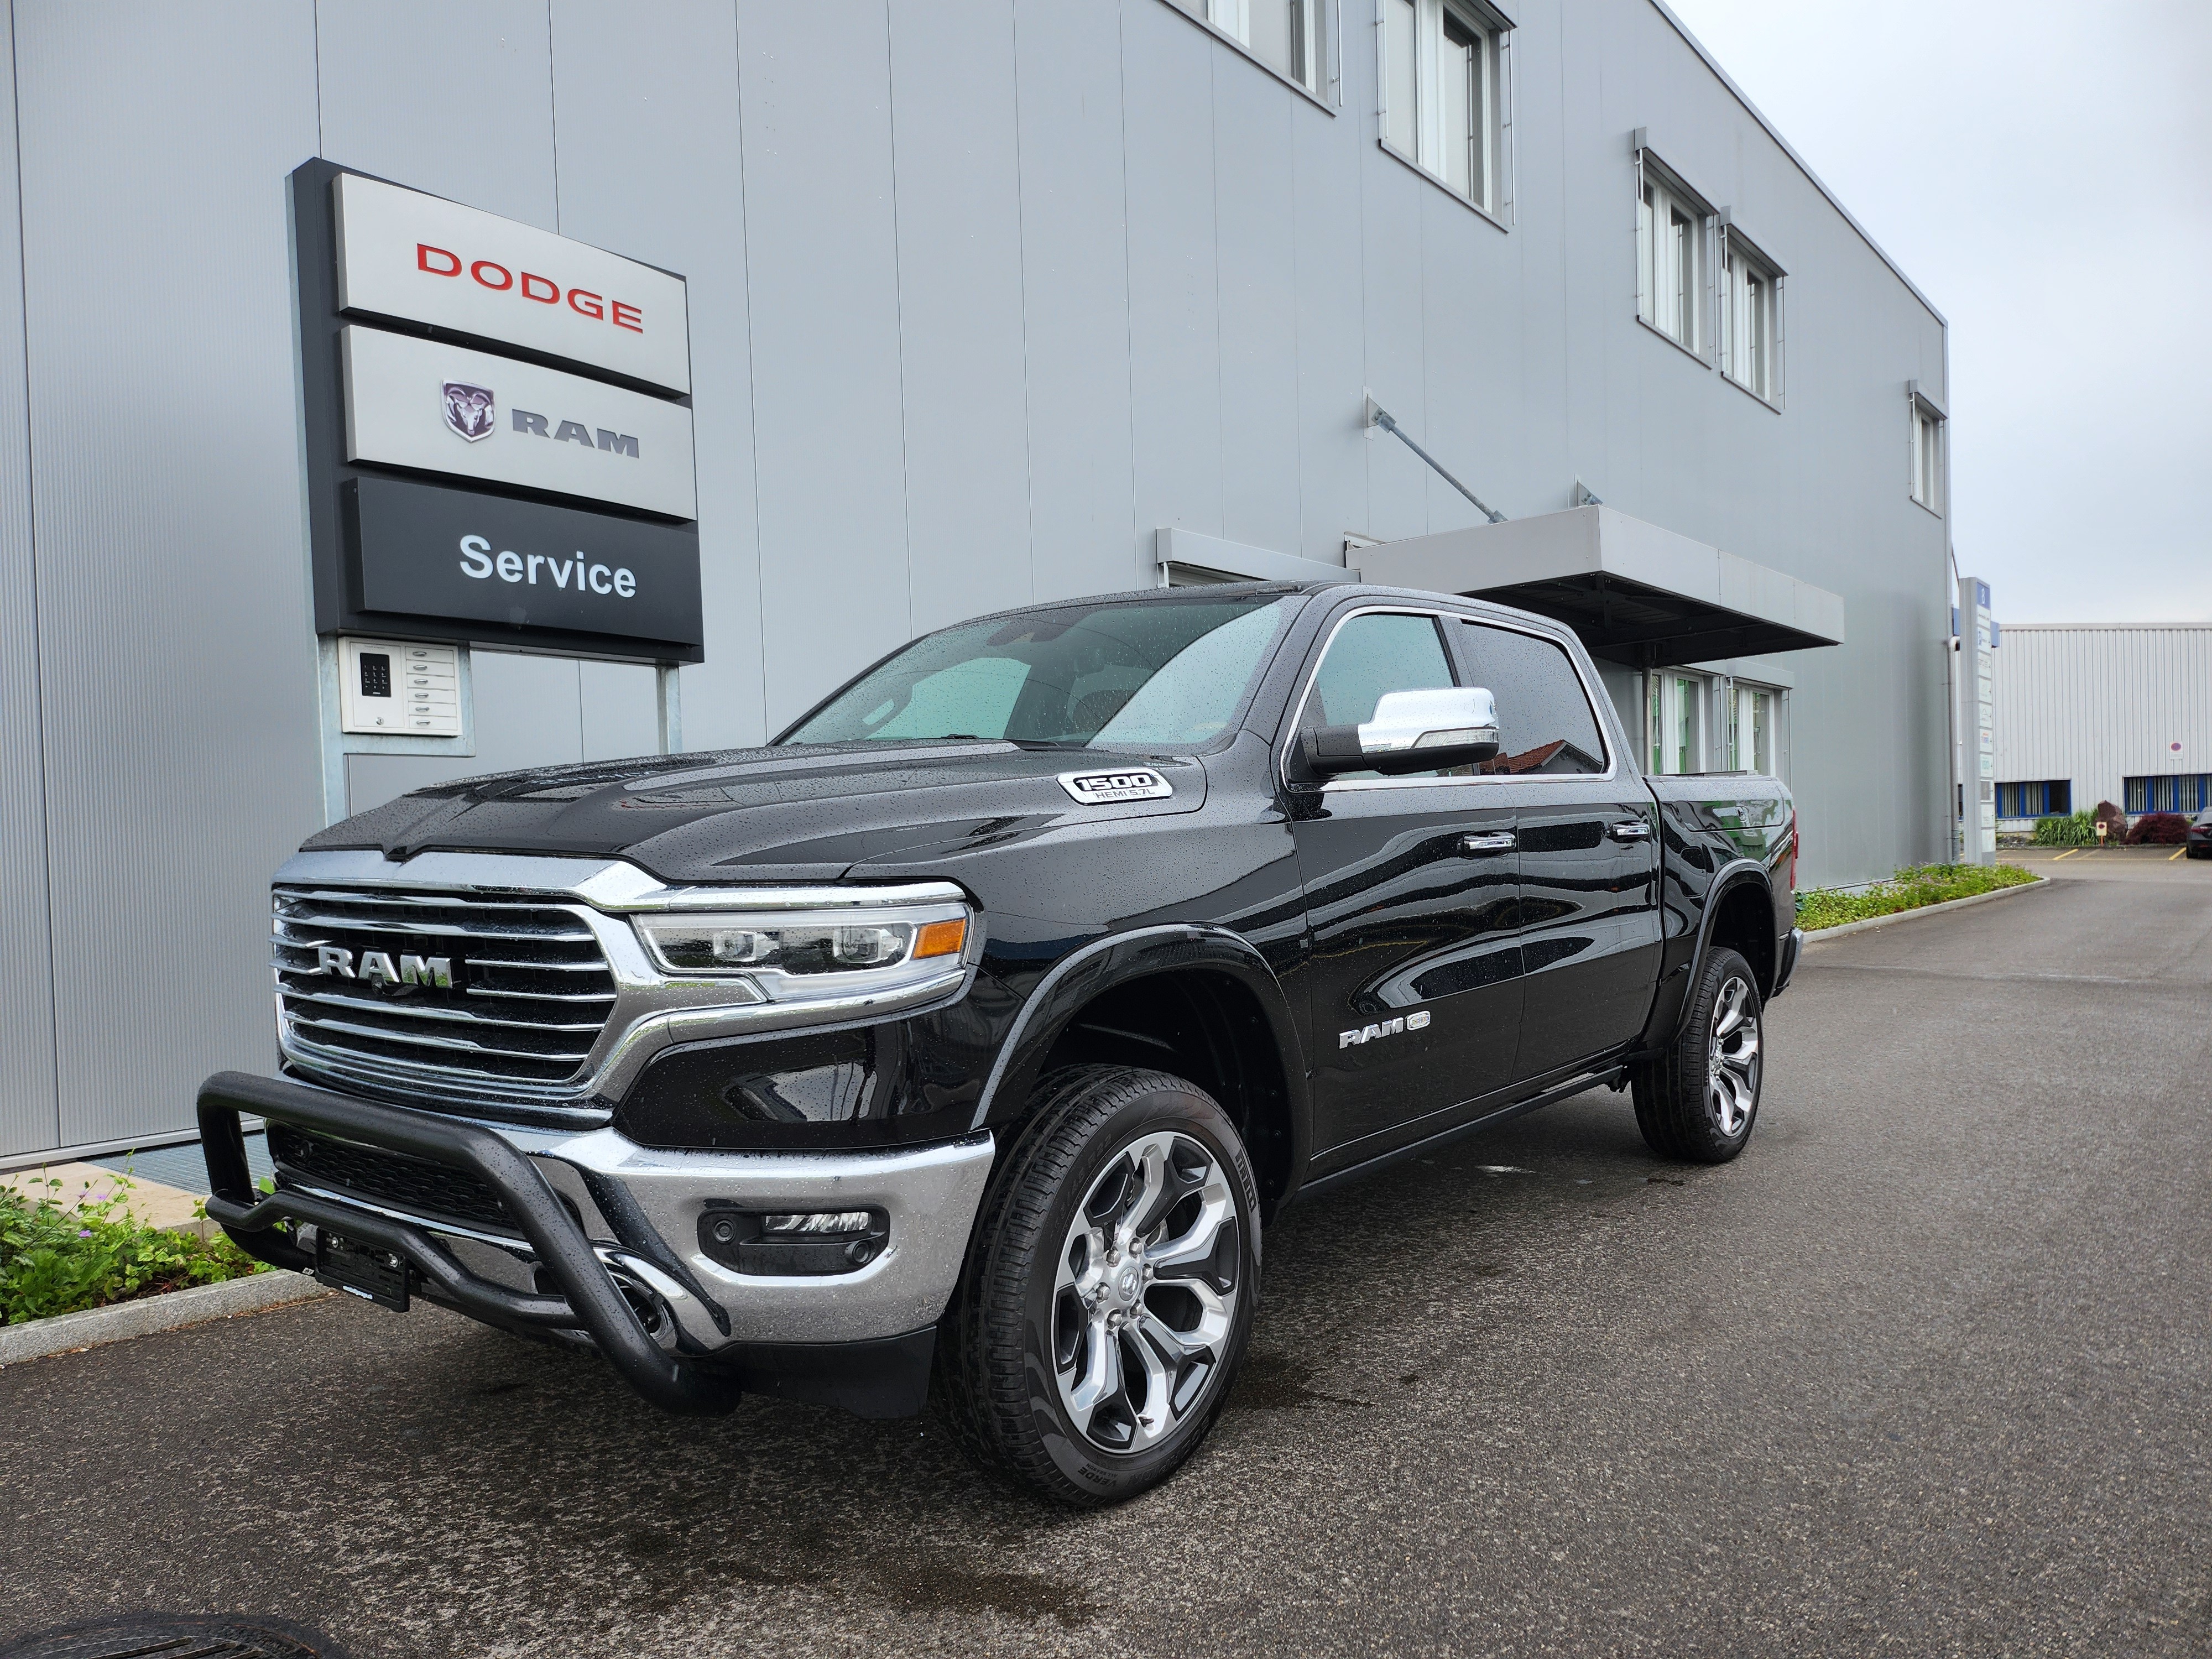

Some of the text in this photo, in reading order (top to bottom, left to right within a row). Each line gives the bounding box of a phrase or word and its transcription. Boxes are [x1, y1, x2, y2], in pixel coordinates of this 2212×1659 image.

[417, 243, 644, 333] DODGE
[512, 409, 640, 458] RAM
[460, 535, 637, 598] Service
[1076, 774, 1152, 791] 1500
[1095, 787, 1156, 799] HEMI 5.7L
[318, 946, 453, 989] RAM
[1339, 1017, 1404, 1050] RAM
[1235, 1148, 1257, 1213] PIRELLI
[1077, 1467, 1116, 1488] VERDE
